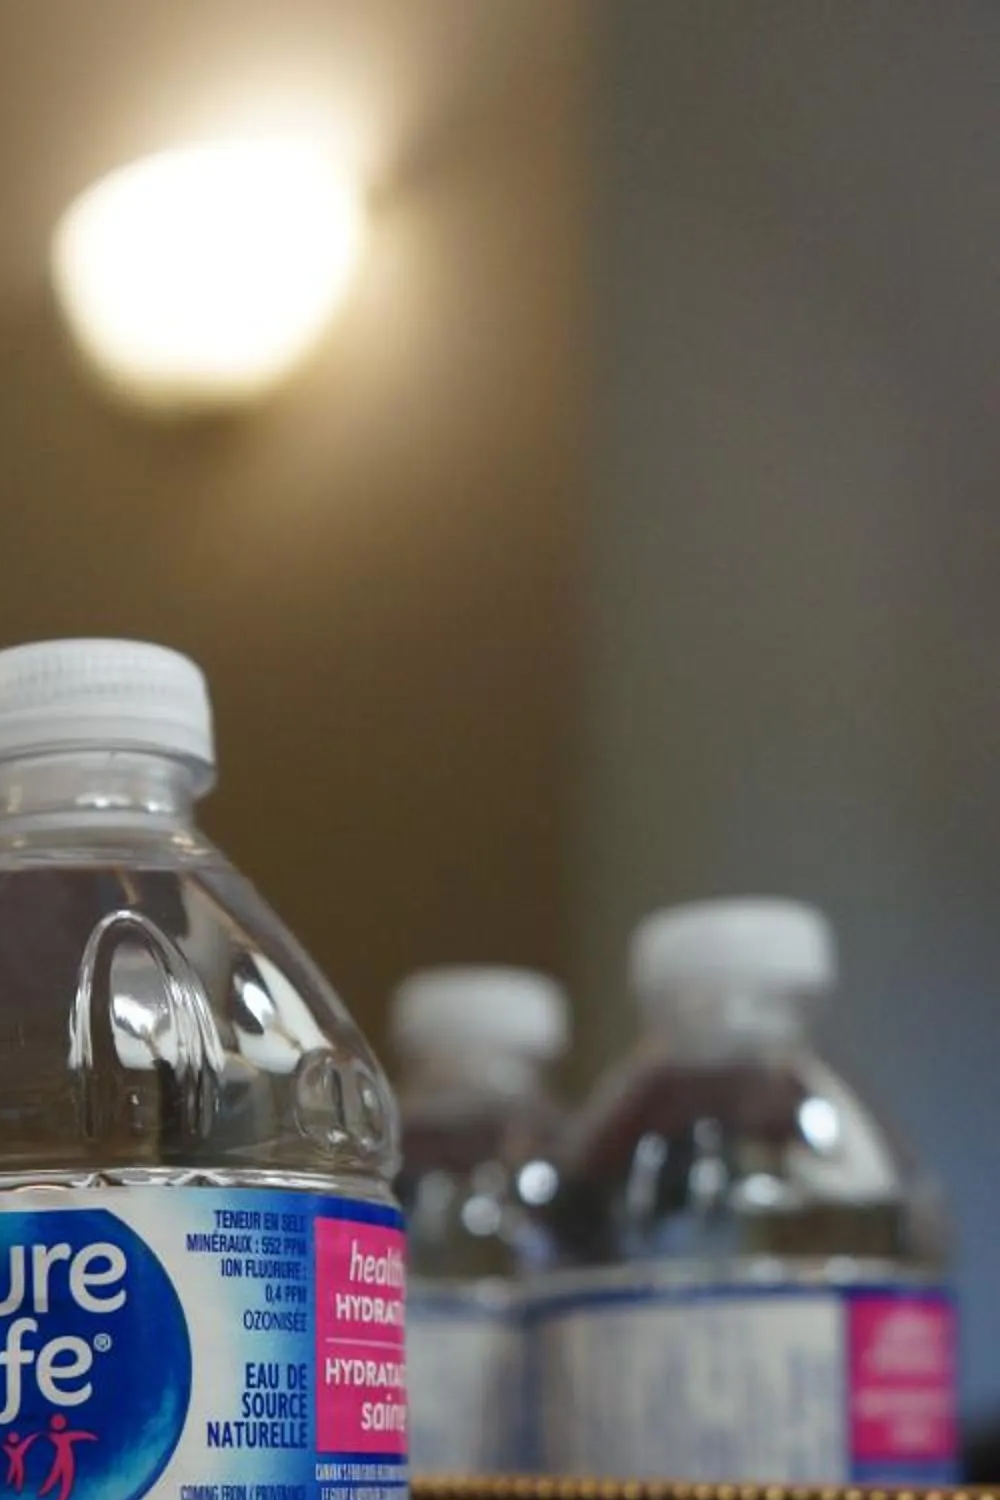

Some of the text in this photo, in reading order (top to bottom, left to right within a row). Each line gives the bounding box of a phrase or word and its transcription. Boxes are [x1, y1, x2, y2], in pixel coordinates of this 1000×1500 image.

[215, 1210, 261, 1230] TENEUR
[220, 1259, 242, 1277] ION
[245, 1362, 307, 1390] EAU DE
[242, 1392, 307, 1419] SOURCE
[206, 1421, 307, 1449] NATURELLE
